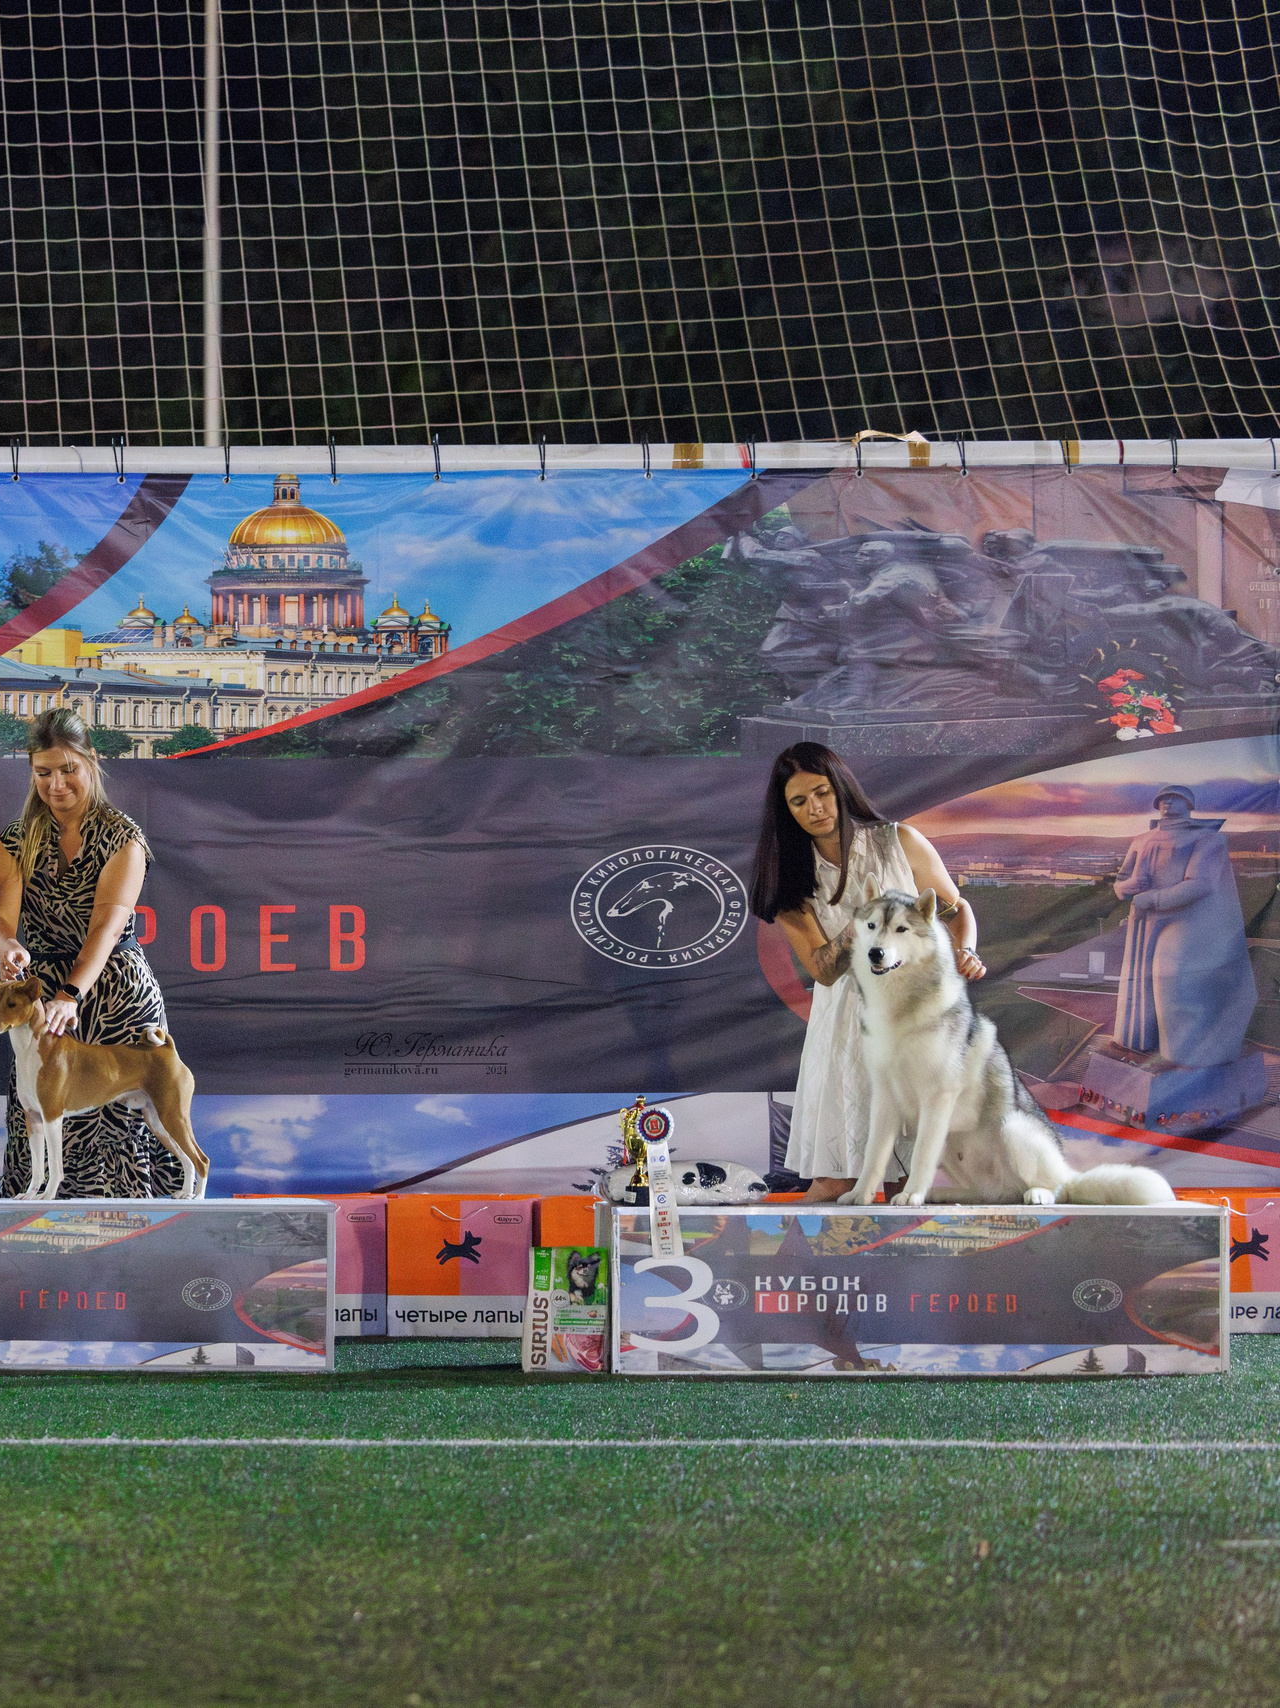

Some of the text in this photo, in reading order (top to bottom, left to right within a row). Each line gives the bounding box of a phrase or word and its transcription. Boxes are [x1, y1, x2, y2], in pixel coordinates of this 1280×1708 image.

[578, 850, 741, 963] РОССИЙСКАЯ КИНОЛОГИЧЕСКАЯ ФЕДЕРАЦИЯ
[755, 1276, 860, 1291] КУБОК
[19, 1290, 127, 1310] ГЕРОЕВ
[629, 1256, 720, 1351] 3
[758, 1293, 1018, 1315] ГОРОДОВ ГЕРОЕВ
[395, 1309, 523, 1323] четыре лапы
[531, 1296, 549, 1366] SIRIUS
